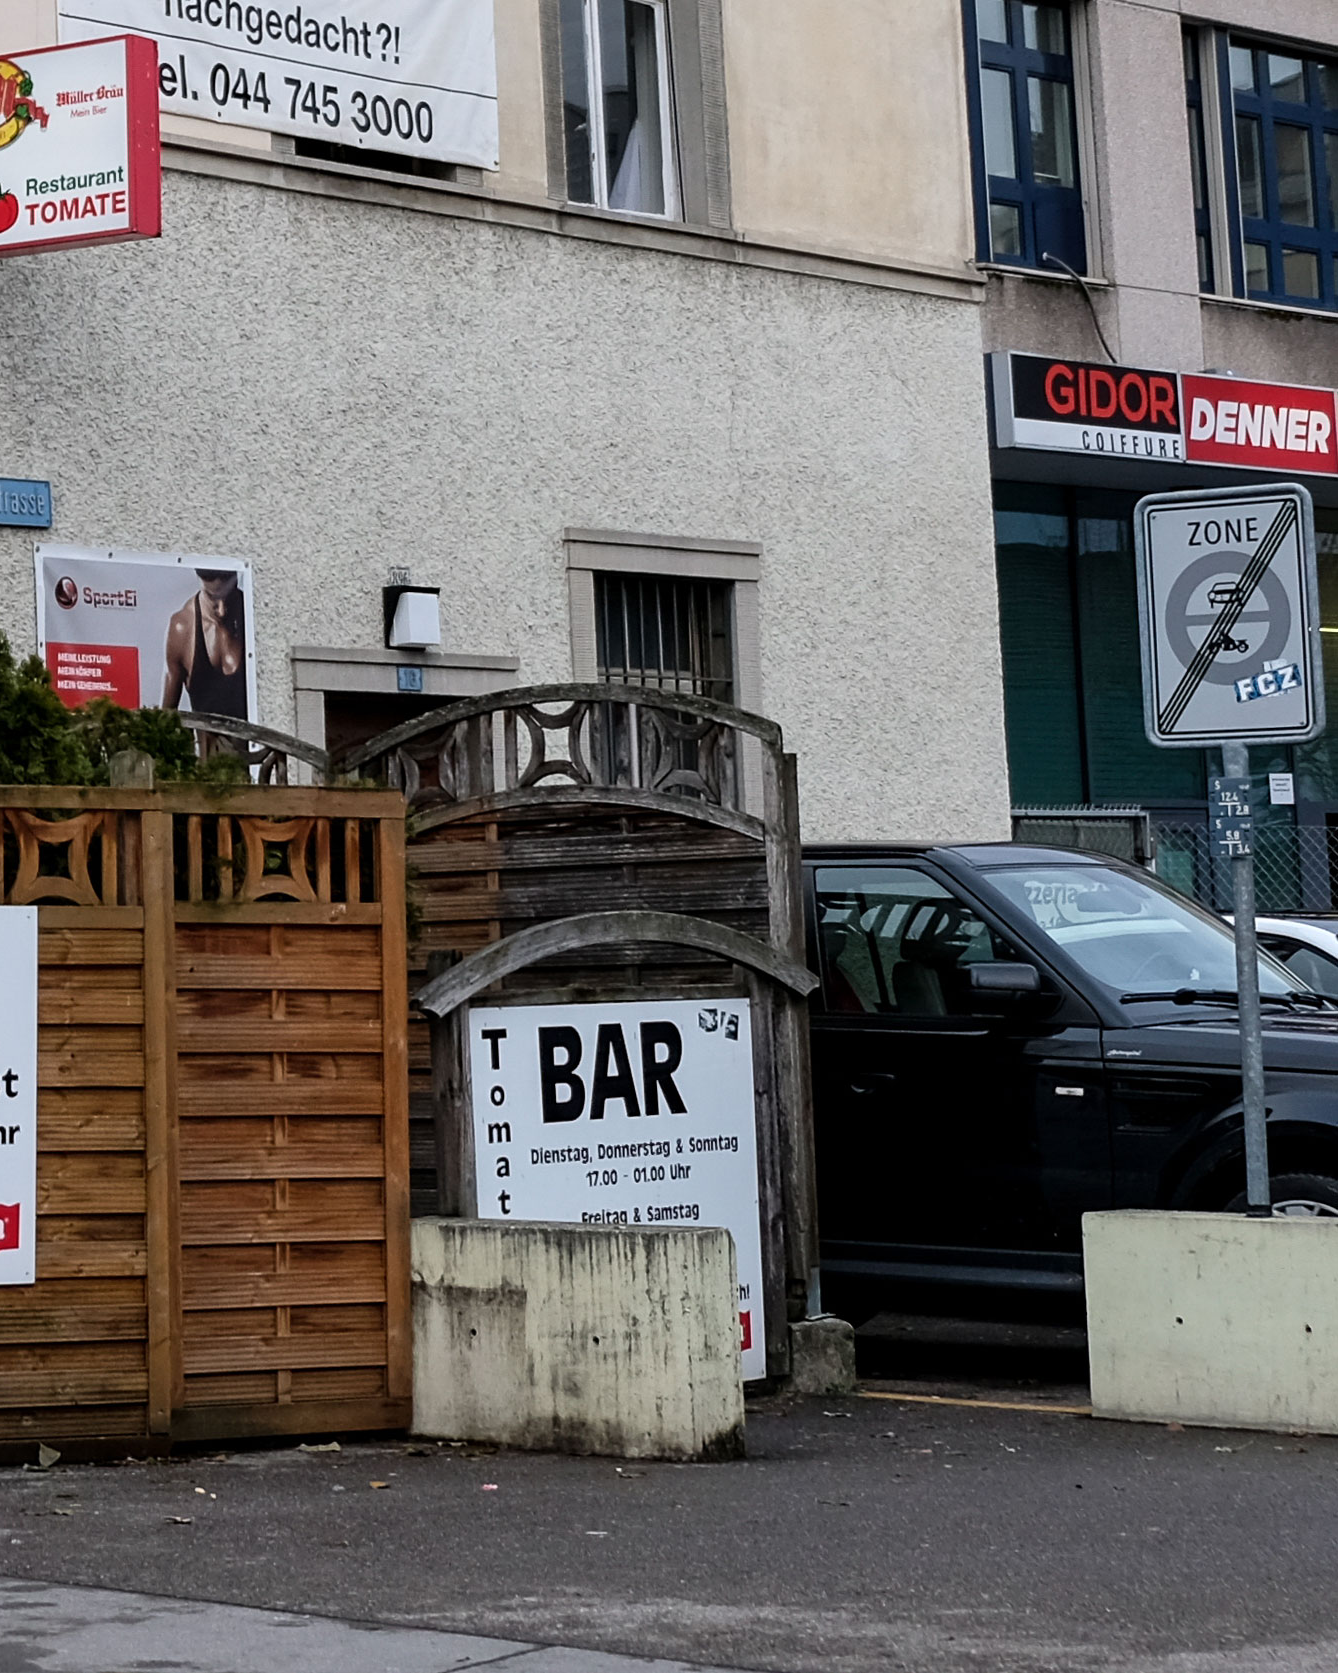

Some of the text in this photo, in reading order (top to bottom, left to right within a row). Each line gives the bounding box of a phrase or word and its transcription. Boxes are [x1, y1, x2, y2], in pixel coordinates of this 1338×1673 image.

[56, 91, 94, 108] Müller
[70, 108, 91, 118] Mein
[158, 53, 434, 144] el. 044 745 3000
[26, 166, 124, 196] Restaurant
[25, 190, 126, 225] TOMATE
[1044, 364, 1177, 426] GIDOR
[1190, 398, 1331, 454] DENNER
[1082, 430, 1180, 459] COIFFURE
[1187, 518, 1258, 546] ZONE
[83, 587, 137, 609] SportEi
[1238, 666, 1297, 701] FCZ
[538, 1020, 688, 1124] BAR
[481, 1028, 512, 1215] Tomat
[531, 1135, 739, 1165] Dienstag, Donnerstag & Sonntag
[586, 1169, 618, 1187] 17.00
[633, 1165, 665, 1183] 01.00
[670, 1163, 691, 1180] Uhr
[633, 1207, 642, 1223] &
[647, 1204, 700, 1222] Samstag
